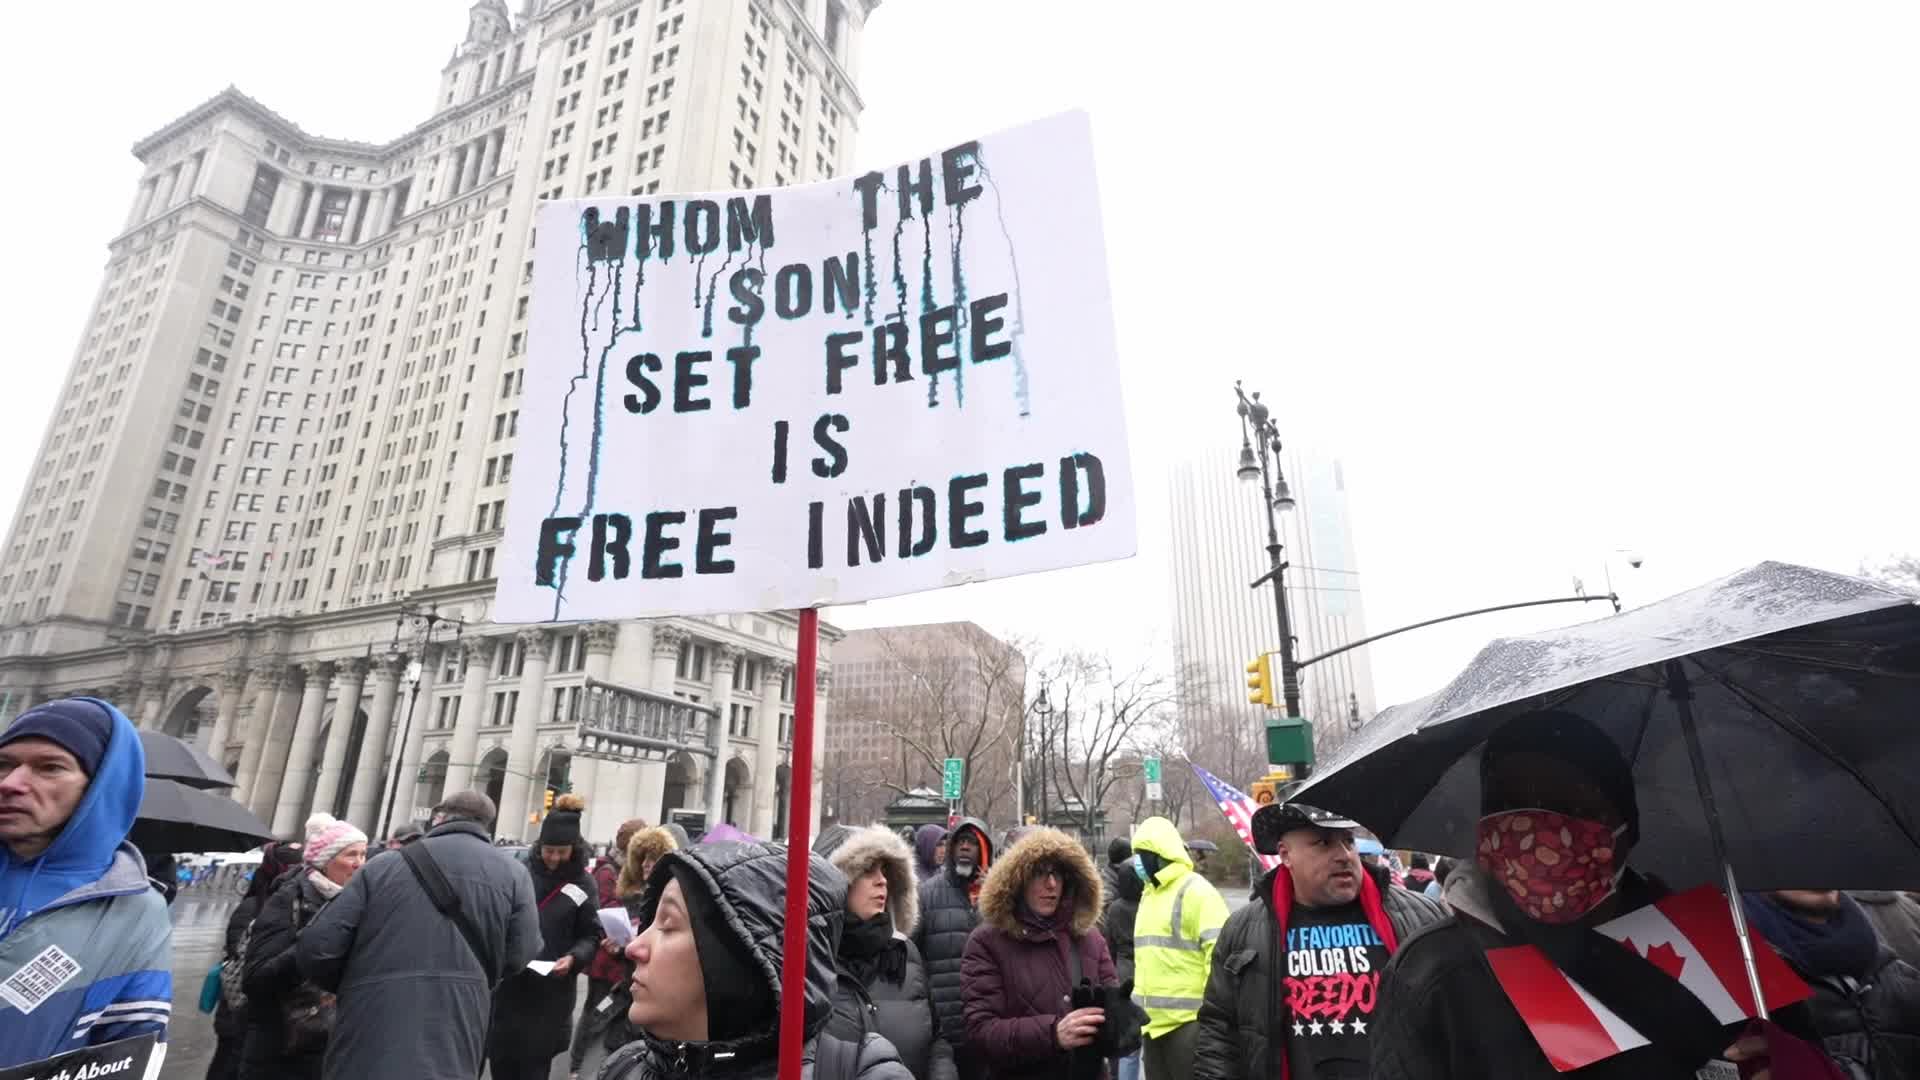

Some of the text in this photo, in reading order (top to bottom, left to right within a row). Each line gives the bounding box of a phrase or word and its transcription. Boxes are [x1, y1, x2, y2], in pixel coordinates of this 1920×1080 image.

[582, 140, 983, 262] WHOM THE
[727, 252, 861, 326] SON
[623, 292, 1012, 415] SET FREE
[772, 413, 850, 484] IS
[535, 452, 1107, 586] FREE INDEED
[1286, 928, 1296, 951] Y
[1287, 946, 1371, 977] COLOR IS
[1282, 970, 1380, 1021] REEDO
[73, 1056, 133, 1080] About
